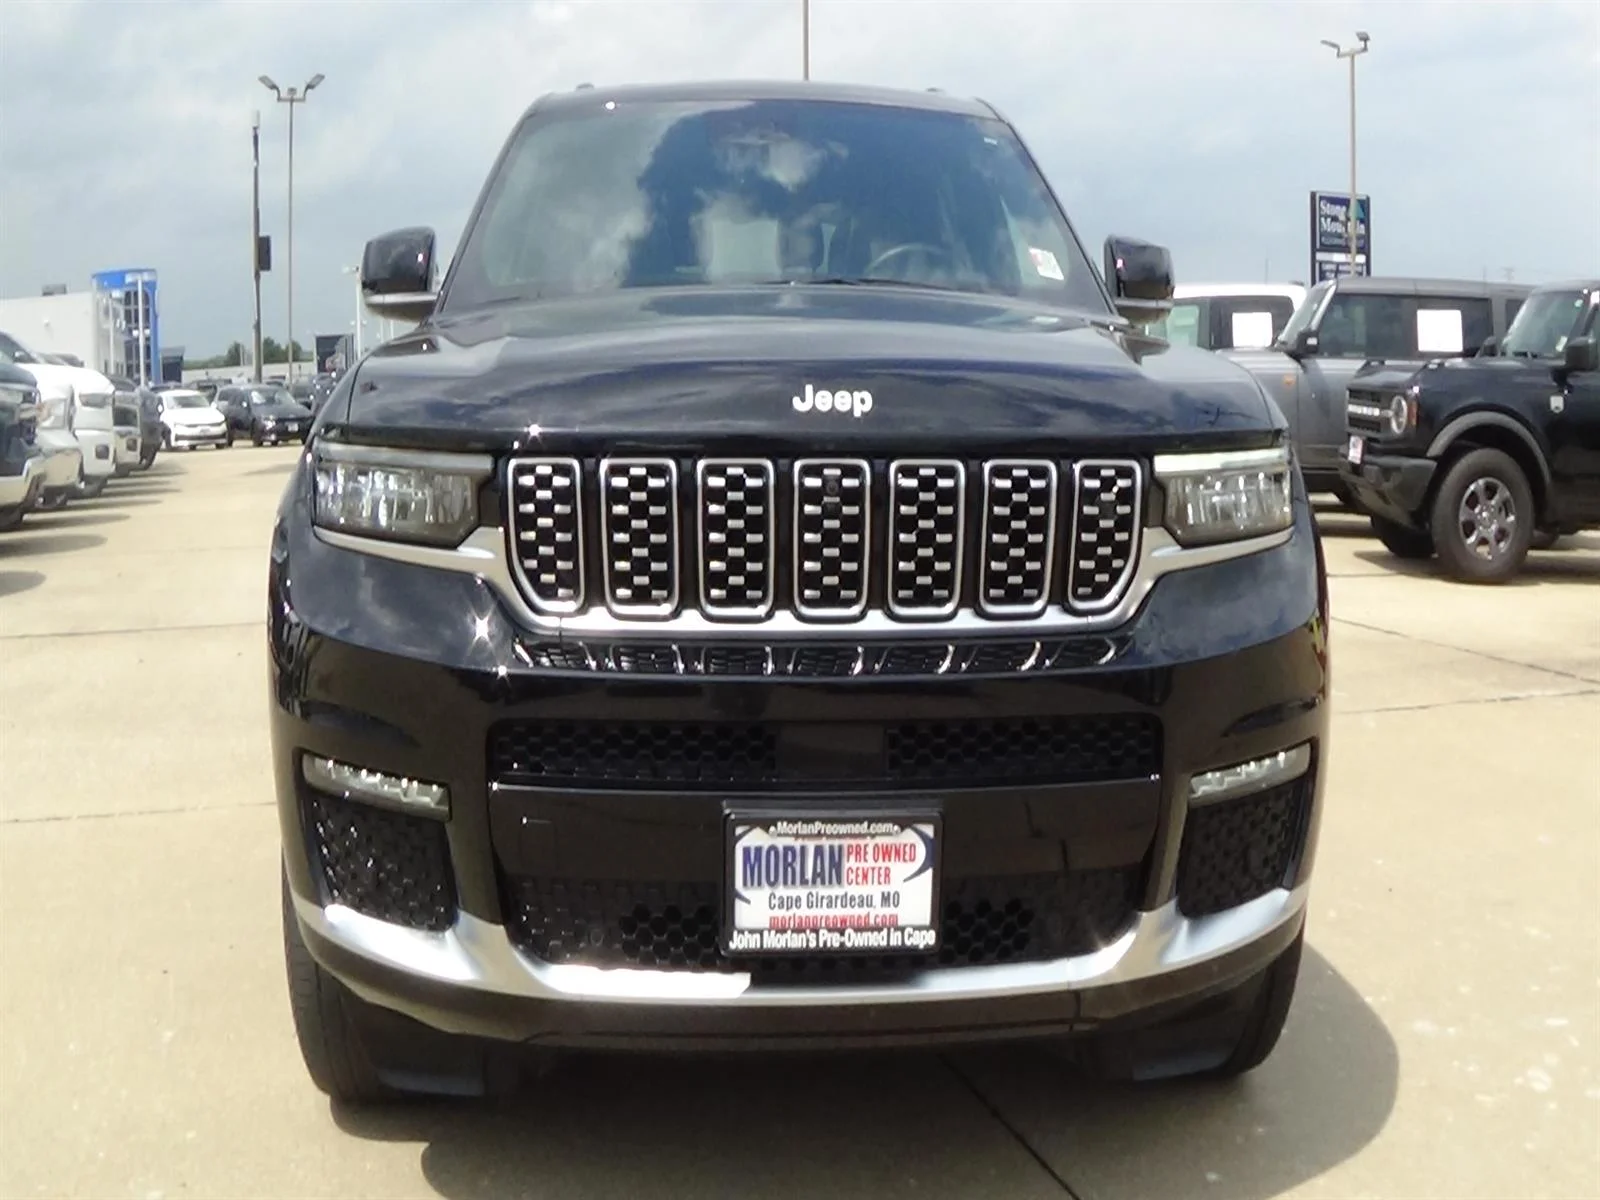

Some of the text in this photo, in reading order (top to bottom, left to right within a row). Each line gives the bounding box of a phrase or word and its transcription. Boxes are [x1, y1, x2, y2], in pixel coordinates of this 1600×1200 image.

[1320, 217, 1365, 235] Mountin
[792, 383, 873, 418] Jeep
[777, 821, 894, 835] MorlanPreowned.com
[742, 843, 916, 887] MORLAN PRE OWNED
[847, 867, 891, 886] CENTER
[768, 891, 900, 911] Cape Girardeau, MO
[769, 912, 899, 928] morlanpreowned.com
[729, 928, 936, 949] John Morlan's Pre-Owned in Cape
